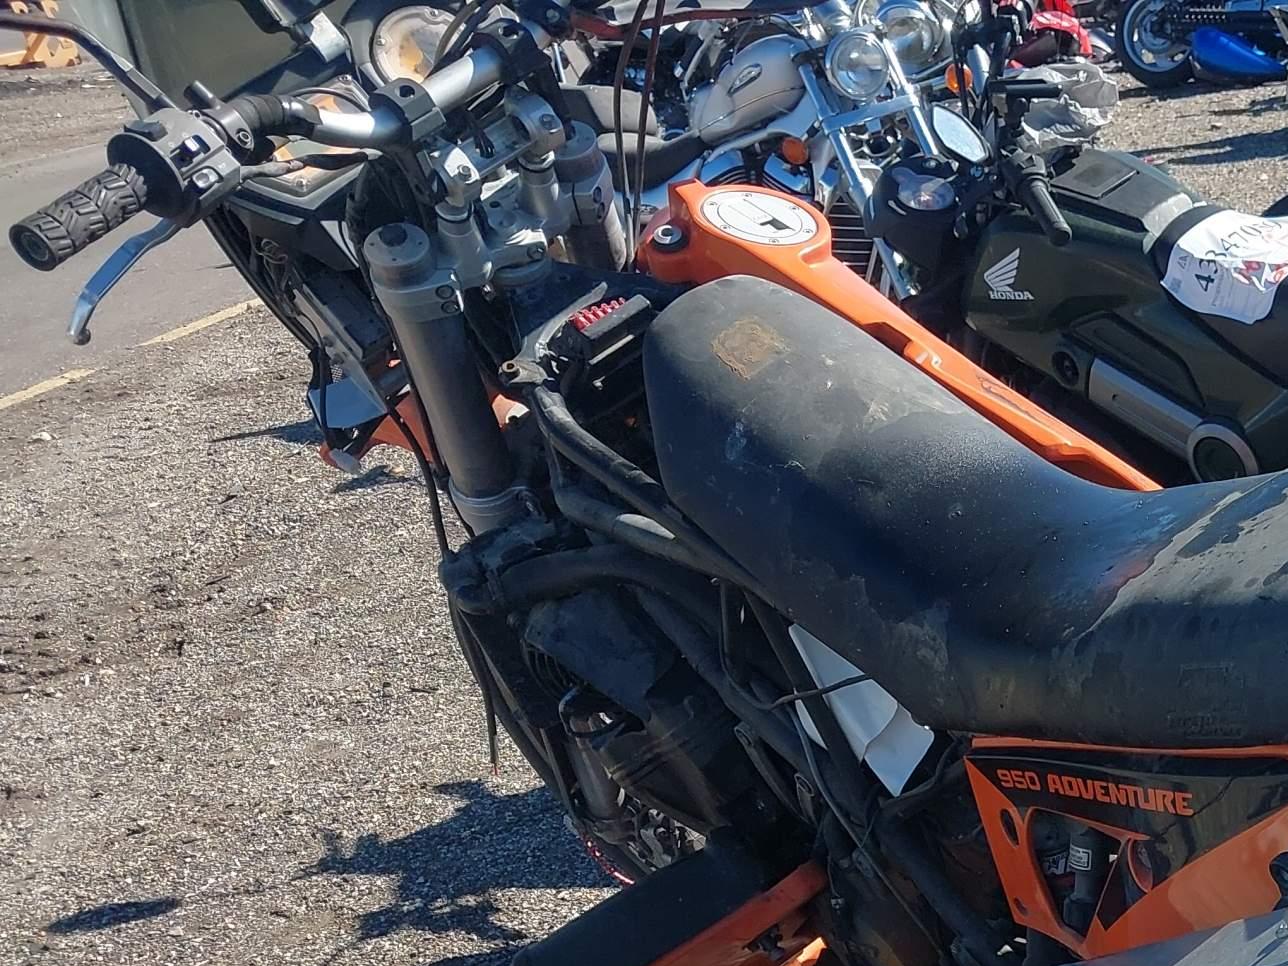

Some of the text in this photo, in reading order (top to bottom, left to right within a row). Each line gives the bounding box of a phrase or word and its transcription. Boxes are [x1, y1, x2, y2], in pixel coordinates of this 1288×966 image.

[987, 290, 1035, 300] HONDA
[996, 769, 1194, 817] 950 ADVENTURE
